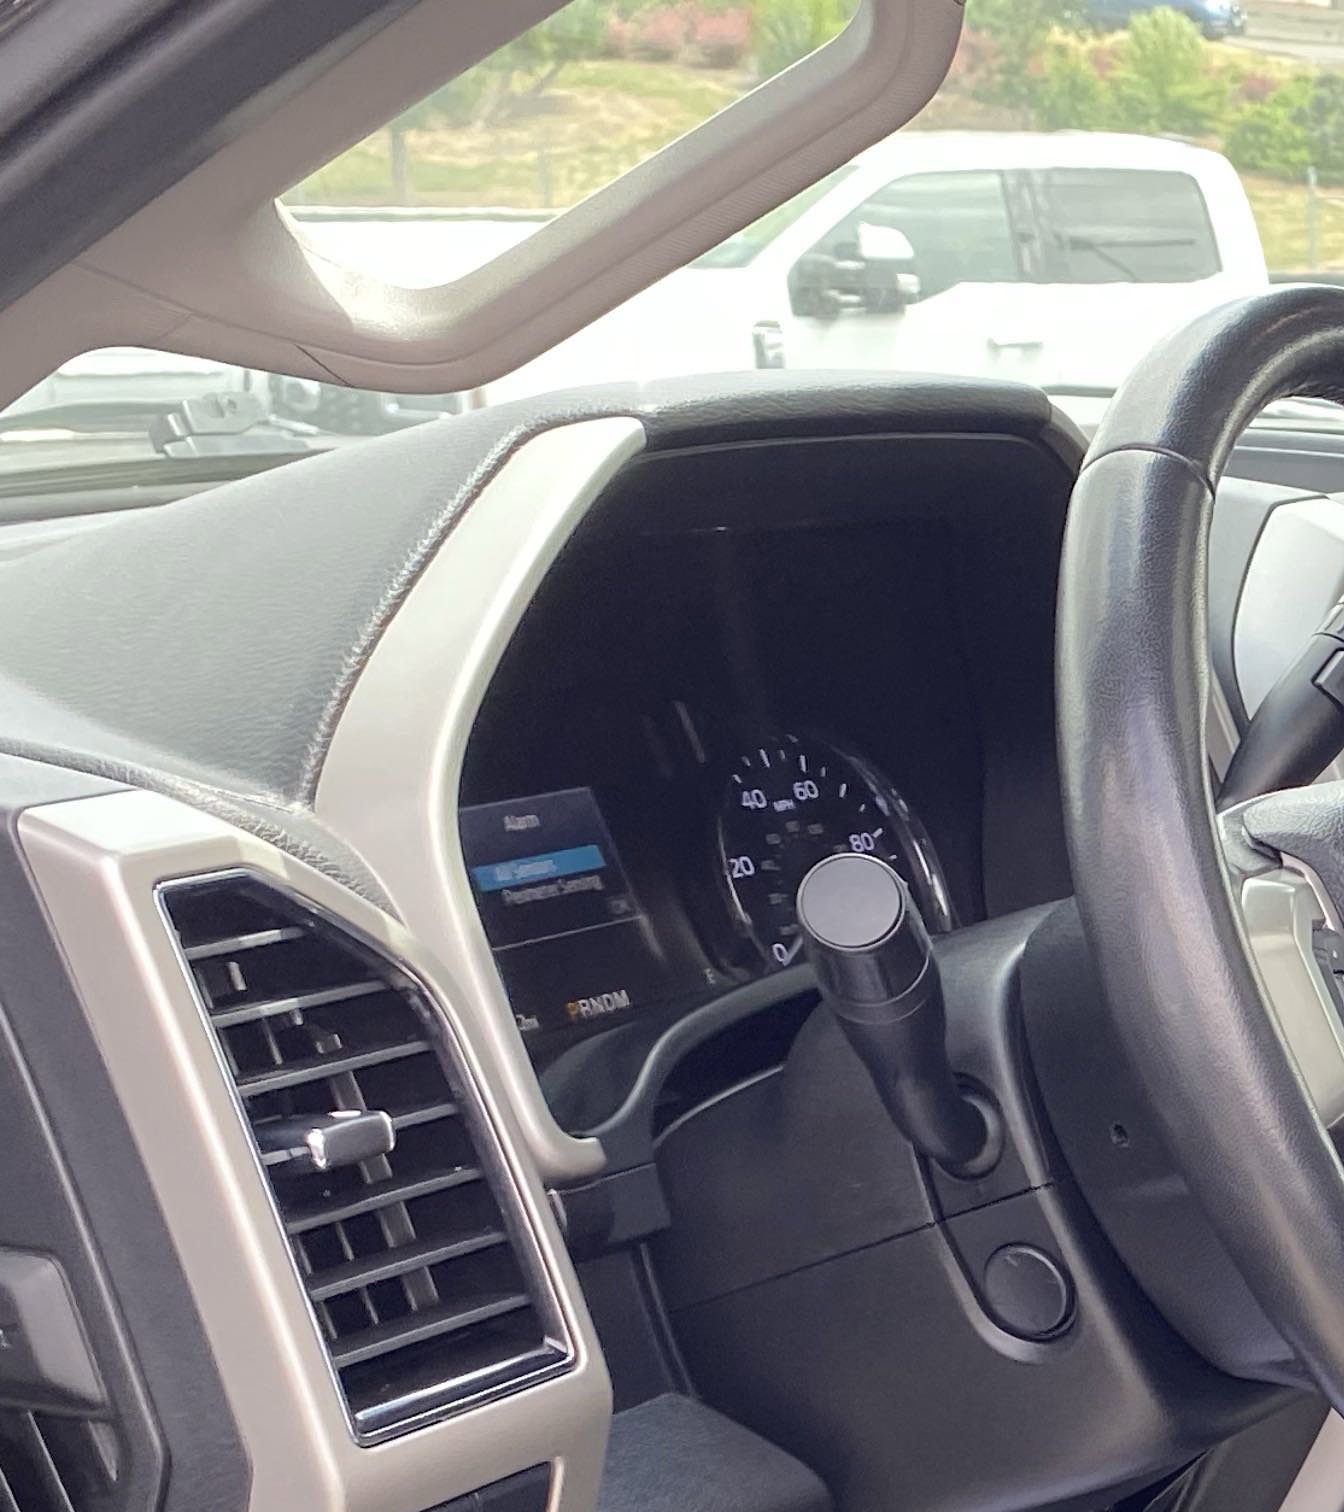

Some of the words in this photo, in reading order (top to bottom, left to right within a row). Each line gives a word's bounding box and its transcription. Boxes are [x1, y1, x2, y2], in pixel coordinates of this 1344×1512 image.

[741, 789, 768, 810] 40
[793, 780, 819, 801] 60
[848, 832, 875, 853] 80
[729, 855, 755, 879] 20
[771, 942, 790, 963] 0
